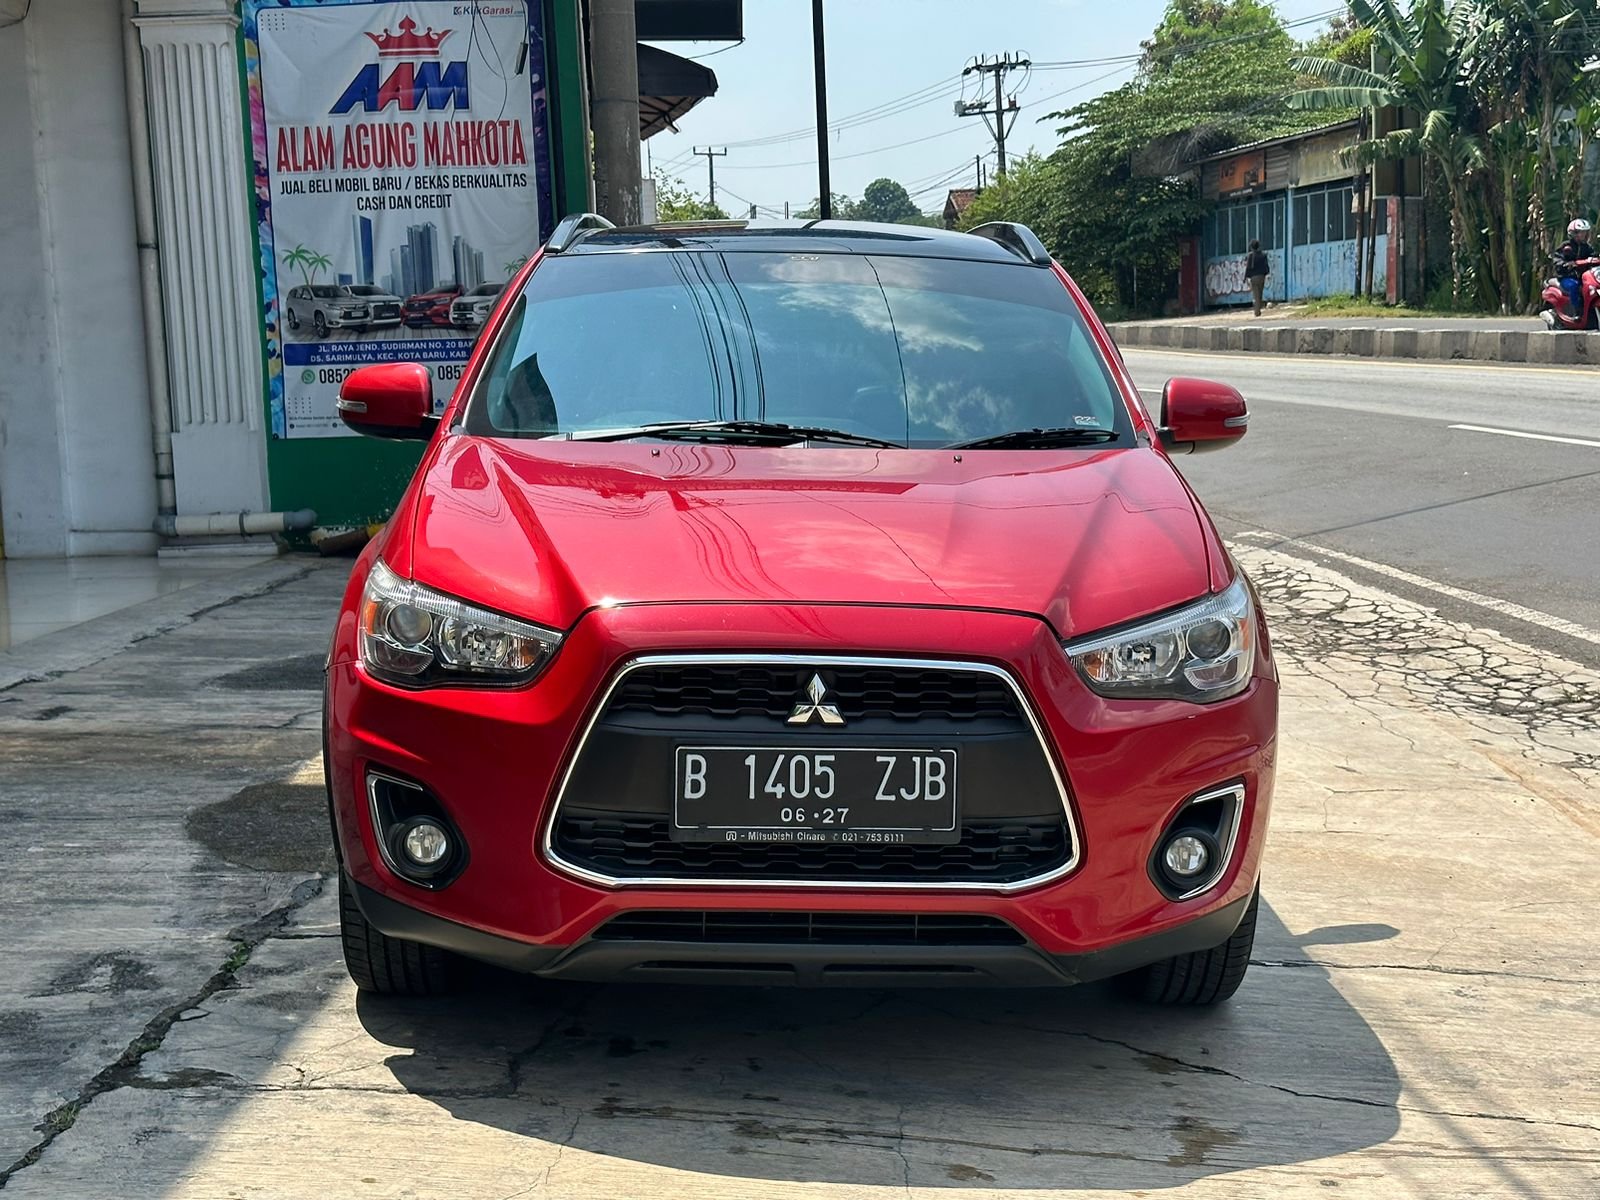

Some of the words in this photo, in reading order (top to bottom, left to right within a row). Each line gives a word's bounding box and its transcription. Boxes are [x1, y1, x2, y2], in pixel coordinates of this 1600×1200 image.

[329, 61, 470, 114] AAM
[277, 126, 335, 173] ALAM
[343, 122, 416, 169] AGUNG
[423, 119, 526, 167] MAHKOTA
[280, 180, 306, 195] JUAL
[309, 178, 332, 194] BELI
[335, 177, 370, 192] MOBIL
[373, 176, 402, 191] BARU
[405, 176, 411, 190] /
[415, 175, 450, 190] BEKAS
[452, 173, 528, 189] BERKUALITAS
[357, 196, 386, 211] CASH
[389, 195, 412, 210] DAN
[415, 194, 452, 210] CREDIT
[318, 345, 330, 353] JL.
[331, 344, 354, 352] RAYA
[356, 343, 380, 352] JEND.
[381, 341, 427, 351] SUDIRMAN
[428, 341, 444, 349] NO.
[445, 341, 457, 349] 20
[310, 355, 324, 363] DS.
[376, 352, 396, 360] KEC.
[397, 351, 421, 360] KOTA
[422, 351, 448, 359] BARU,
[449, 350, 470, 358] KAB.
[319, 368, 357, 384] 0852
[684, 754, 707, 799] B
[744, 754, 836, 800] 1405
[875, 756, 946, 801] ZJB
[748, 831, 794, 841] Mitsubishi
